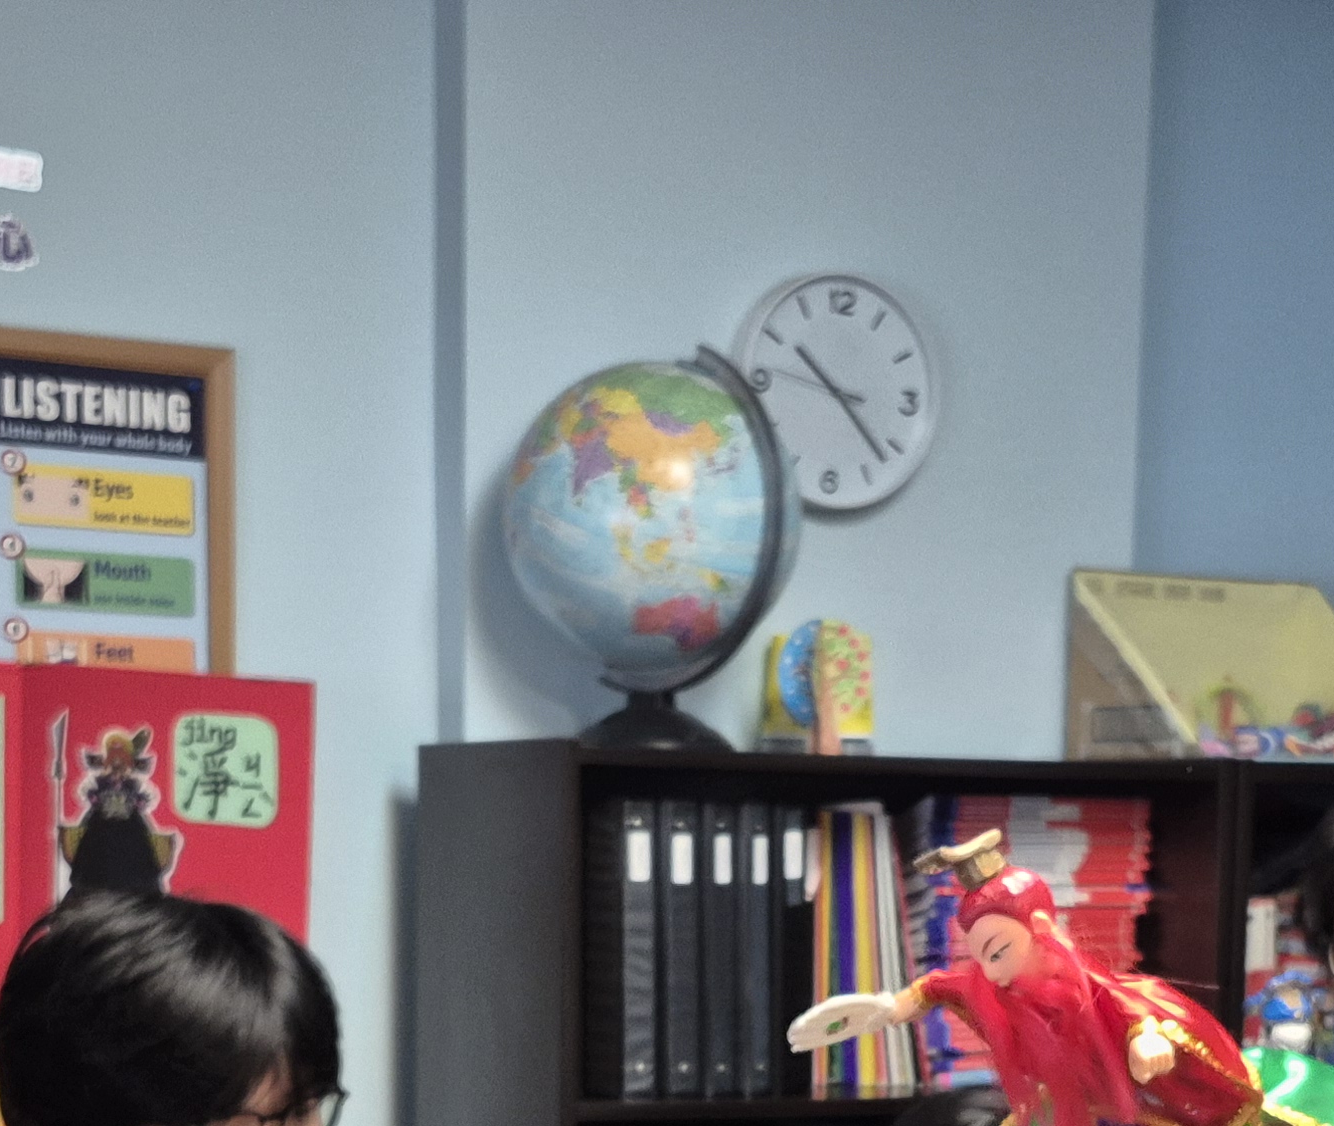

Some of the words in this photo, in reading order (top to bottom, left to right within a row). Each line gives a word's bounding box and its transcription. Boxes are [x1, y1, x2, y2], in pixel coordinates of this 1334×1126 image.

[828, 288, 857, 317] 12
[0, 373, 192, 434] LISTENING
[896, 389, 919, 418] 3
[93, 477, 134, 502] Eyes
[818, 469, 841, 495] 6
[93, 559, 152, 582] Mouth
